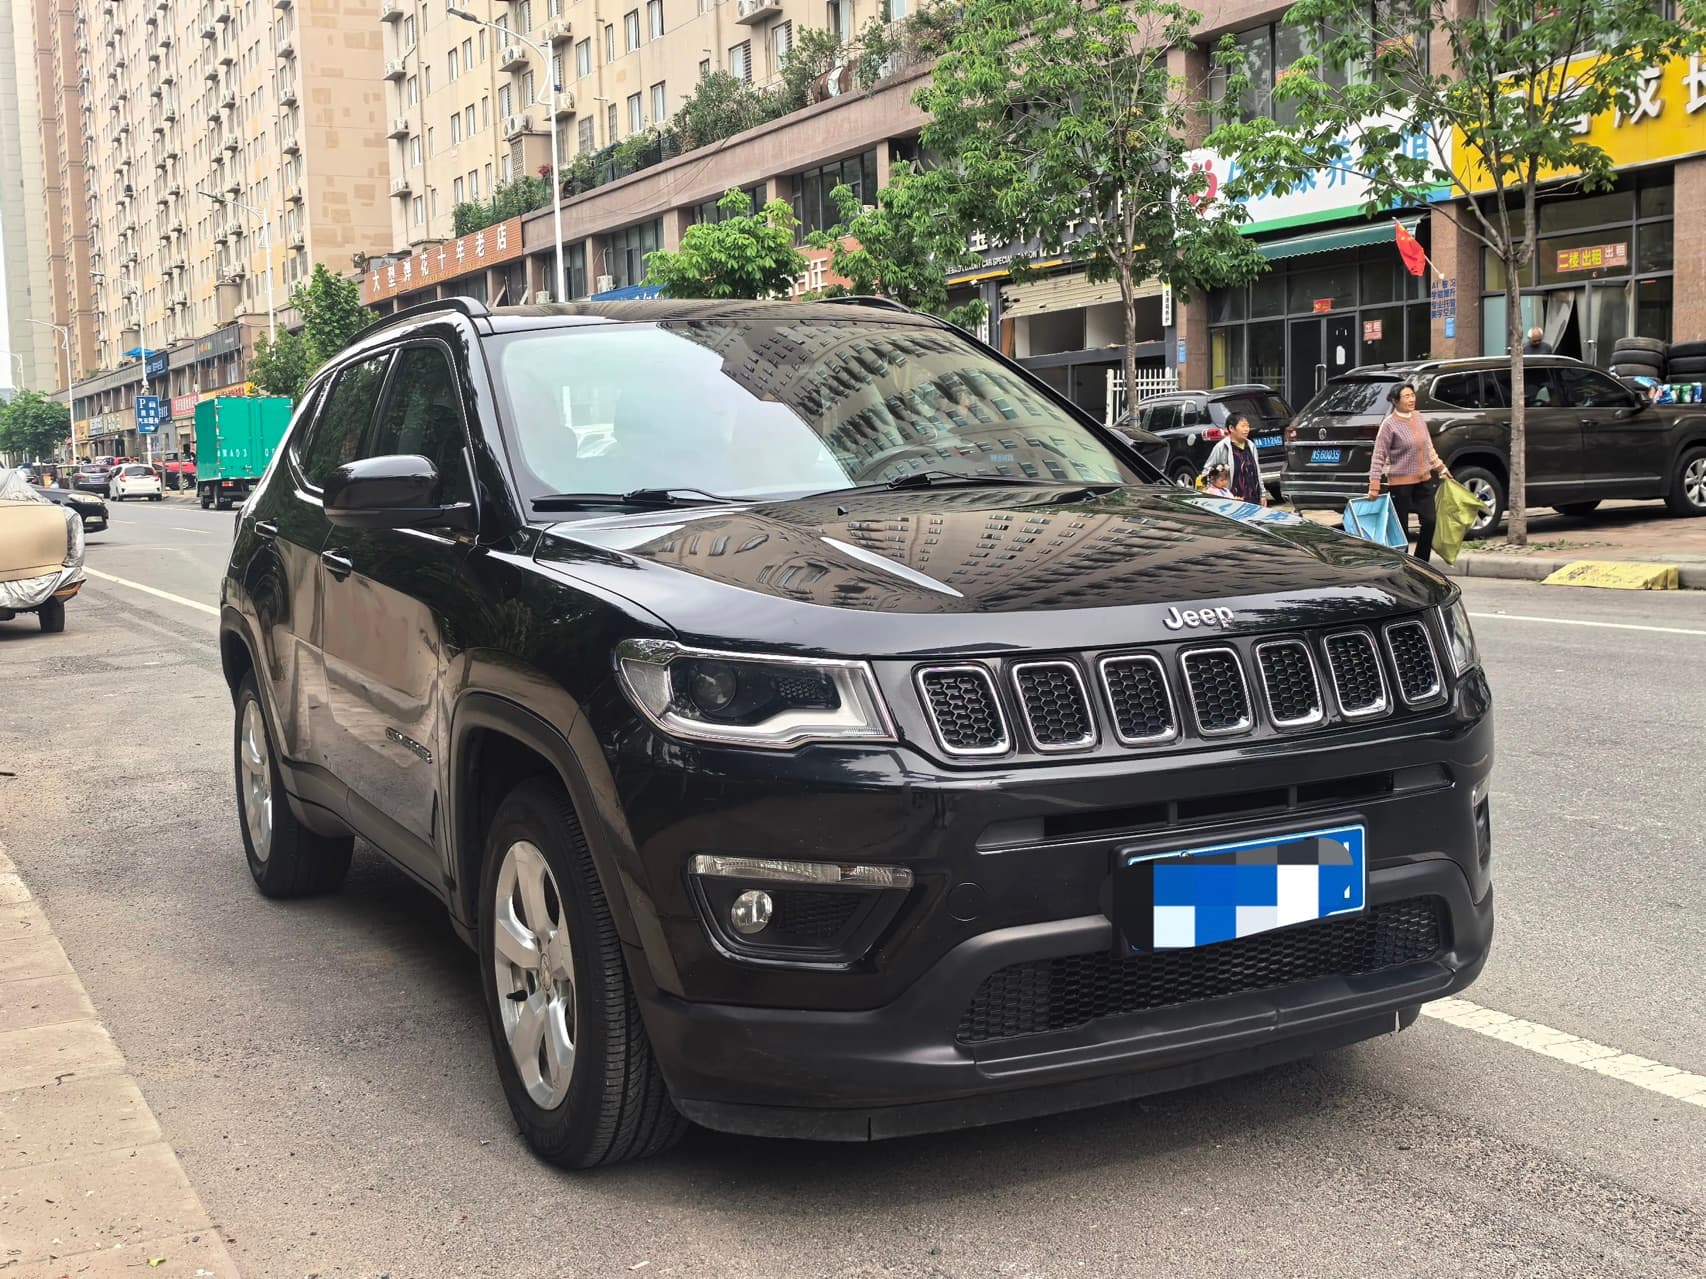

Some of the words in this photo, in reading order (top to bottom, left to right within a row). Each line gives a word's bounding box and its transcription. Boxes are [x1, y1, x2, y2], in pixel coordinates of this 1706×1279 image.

[1559, 248, 1602, 268] 二楼出租
[138, 398, 146, 408] P
[1162, 606, 1235, 631] Jeep
